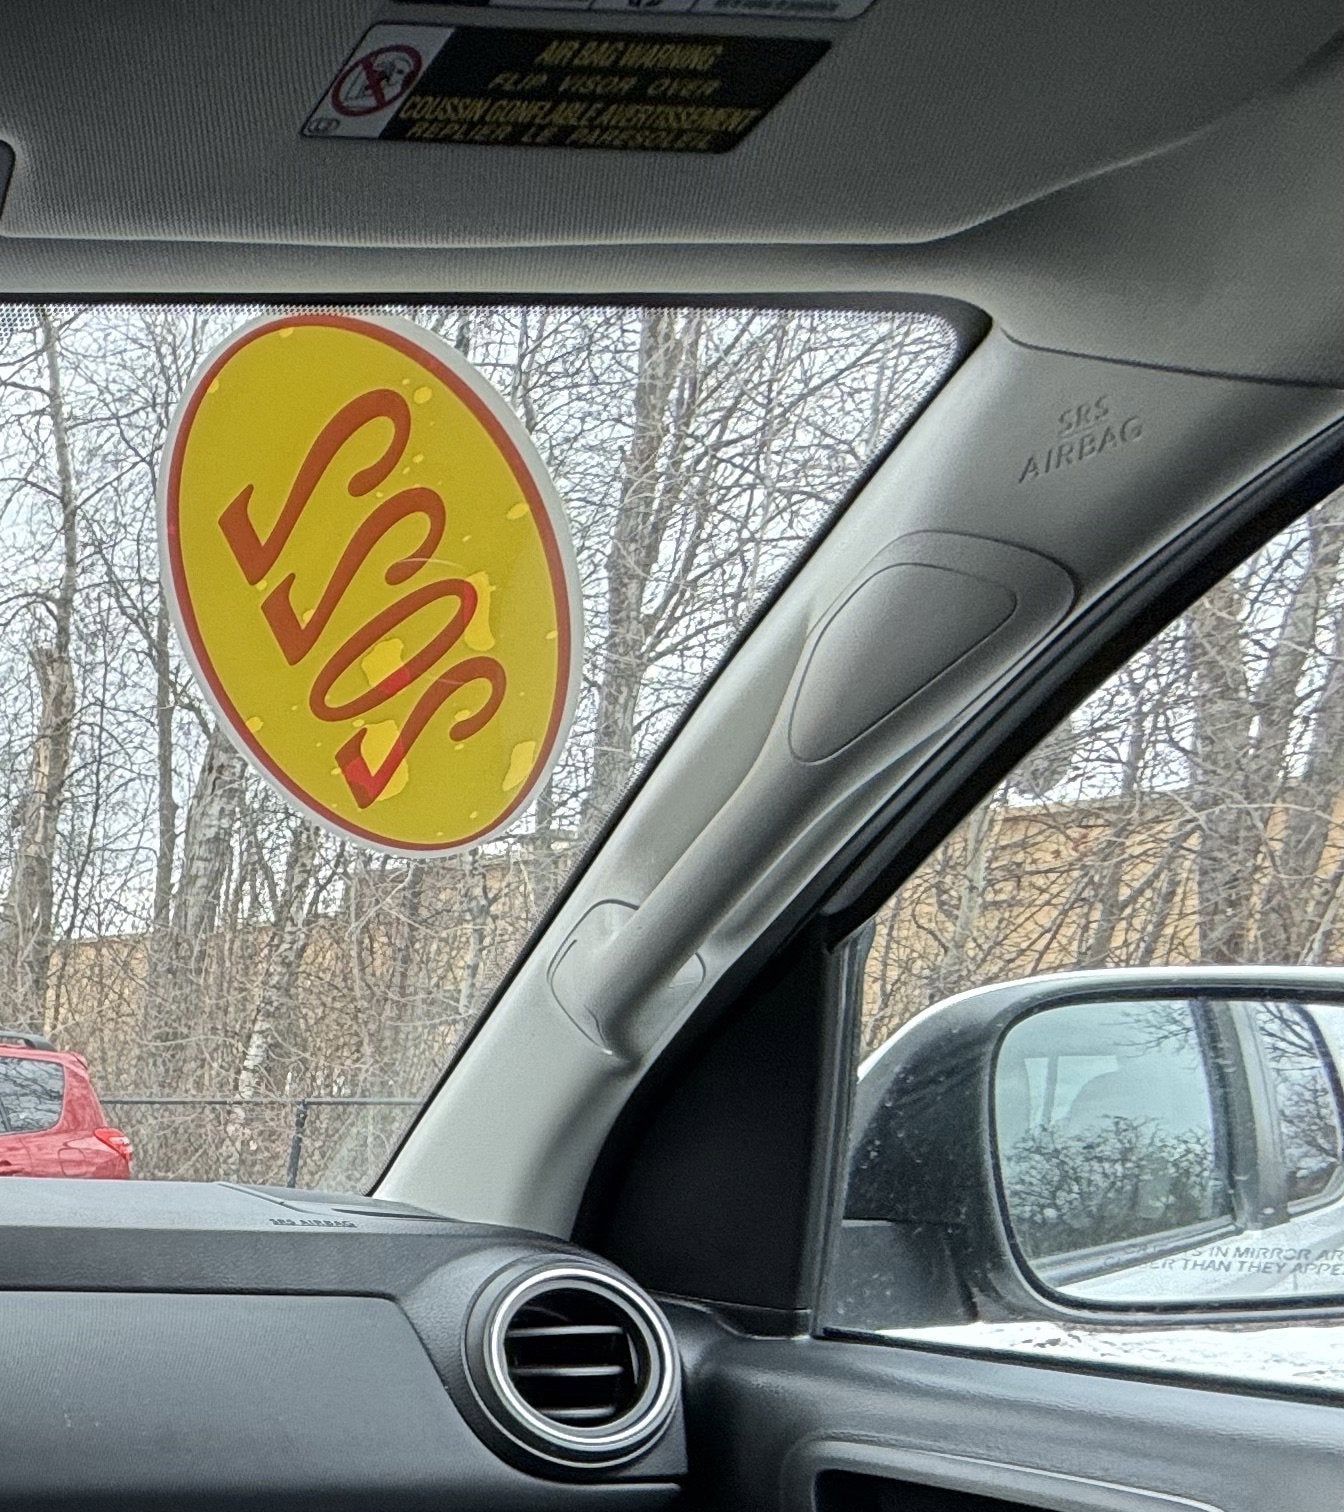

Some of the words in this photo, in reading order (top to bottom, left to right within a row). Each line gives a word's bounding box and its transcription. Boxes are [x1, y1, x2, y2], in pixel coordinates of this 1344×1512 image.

[534, 40, 580, 64] AIR
[573, 40, 625, 66] BAG
[618, 42, 724, 70] WARNING
[487, 70, 548, 91] FLIP
[558, 73, 638, 95] VISOR
[398, 96, 493, 121] COUSSIN
[595, 103, 762, 133] AVERTISSEMENT
[521, 125, 560, 143] LE
[1058, 395, 1110, 431] SRS
[1018, 415, 1143, 484] AIRBAG
[299, 1219, 357, 1228] AIRBAG
[1182, 1258, 1233, 1272] THAN
[1238, 1260, 1286, 1274] THEY
[1210, 1246, 1229, 1257] IN
[1233, 1246, 1312, 1261] MIRROR
[1313, 1249, 1344, 1261] AR
